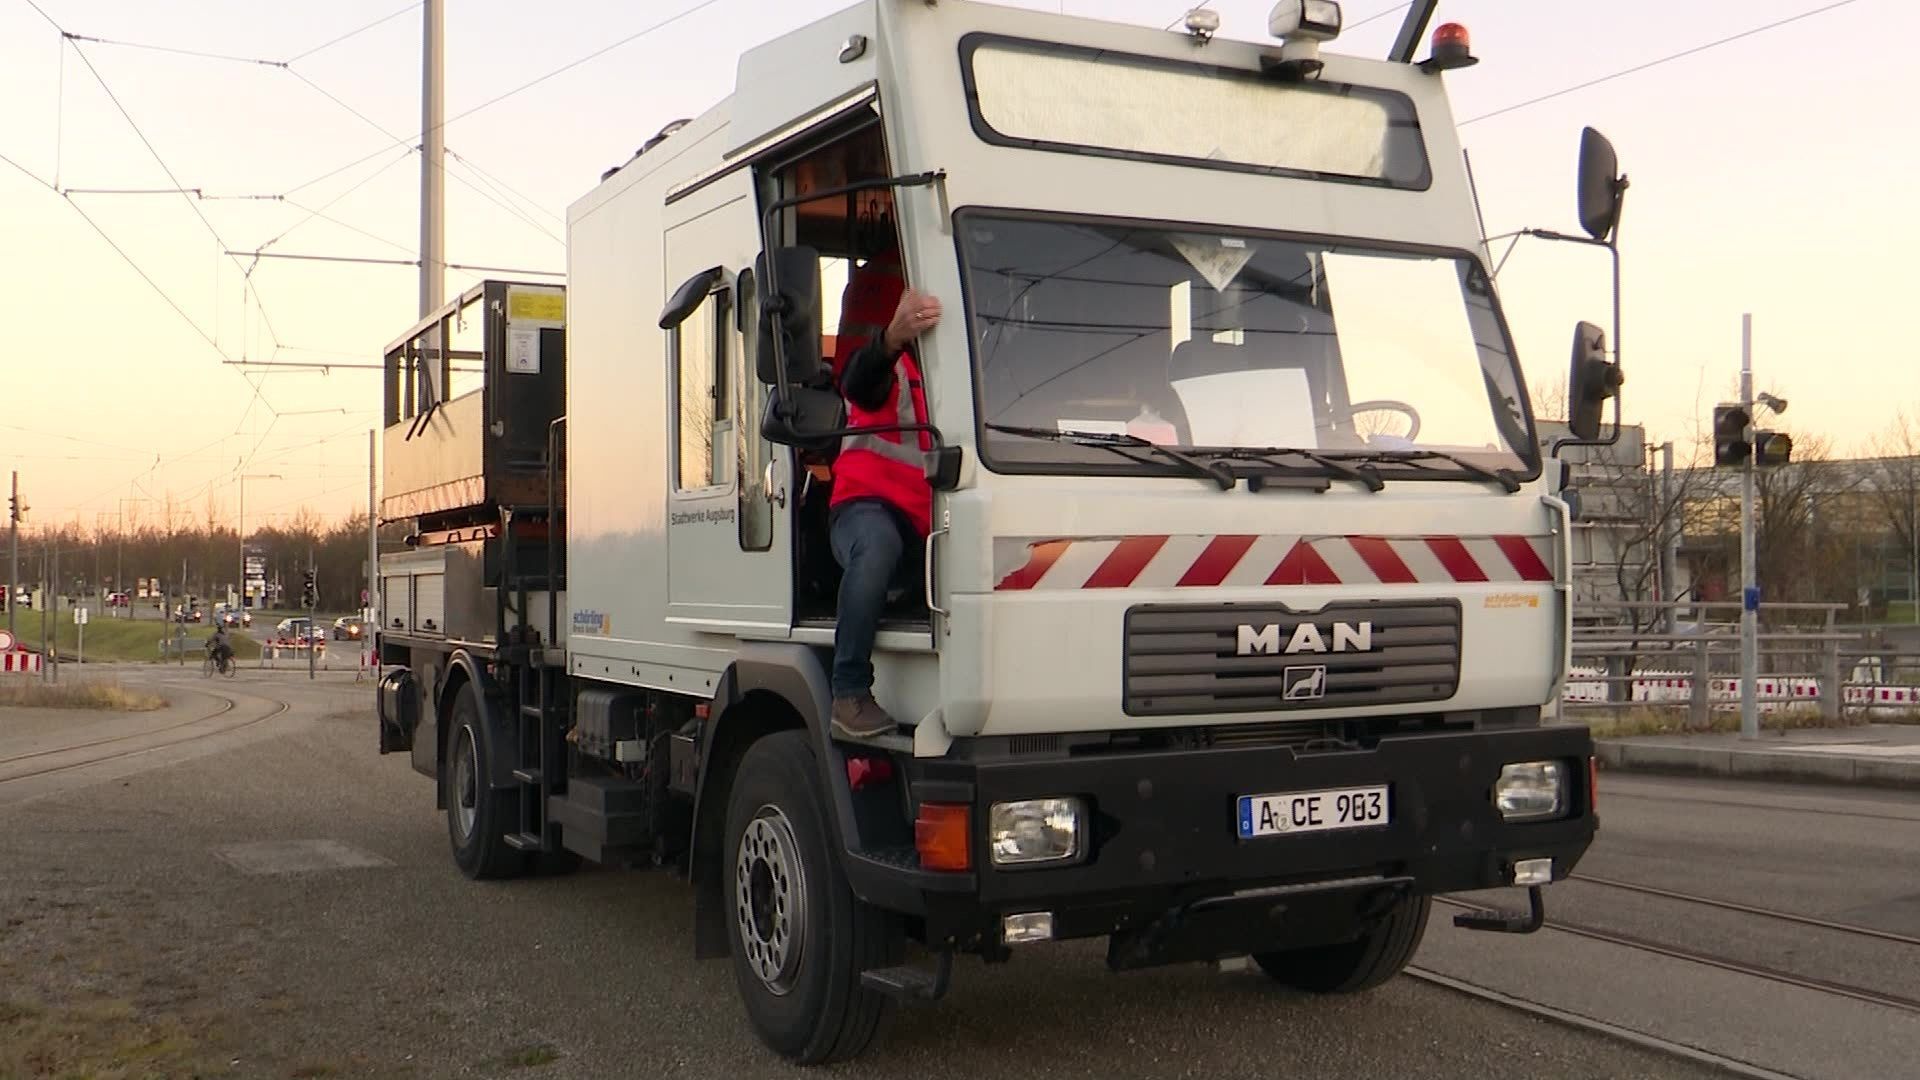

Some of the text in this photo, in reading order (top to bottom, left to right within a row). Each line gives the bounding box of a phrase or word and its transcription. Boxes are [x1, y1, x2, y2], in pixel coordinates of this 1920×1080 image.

[671, 508, 735, 525] Stadtwerke Augsburg
[1237, 621, 1372, 656] MAN
[1260, 801, 1274, 830] A
[1292, 797, 1323, 826] CE
